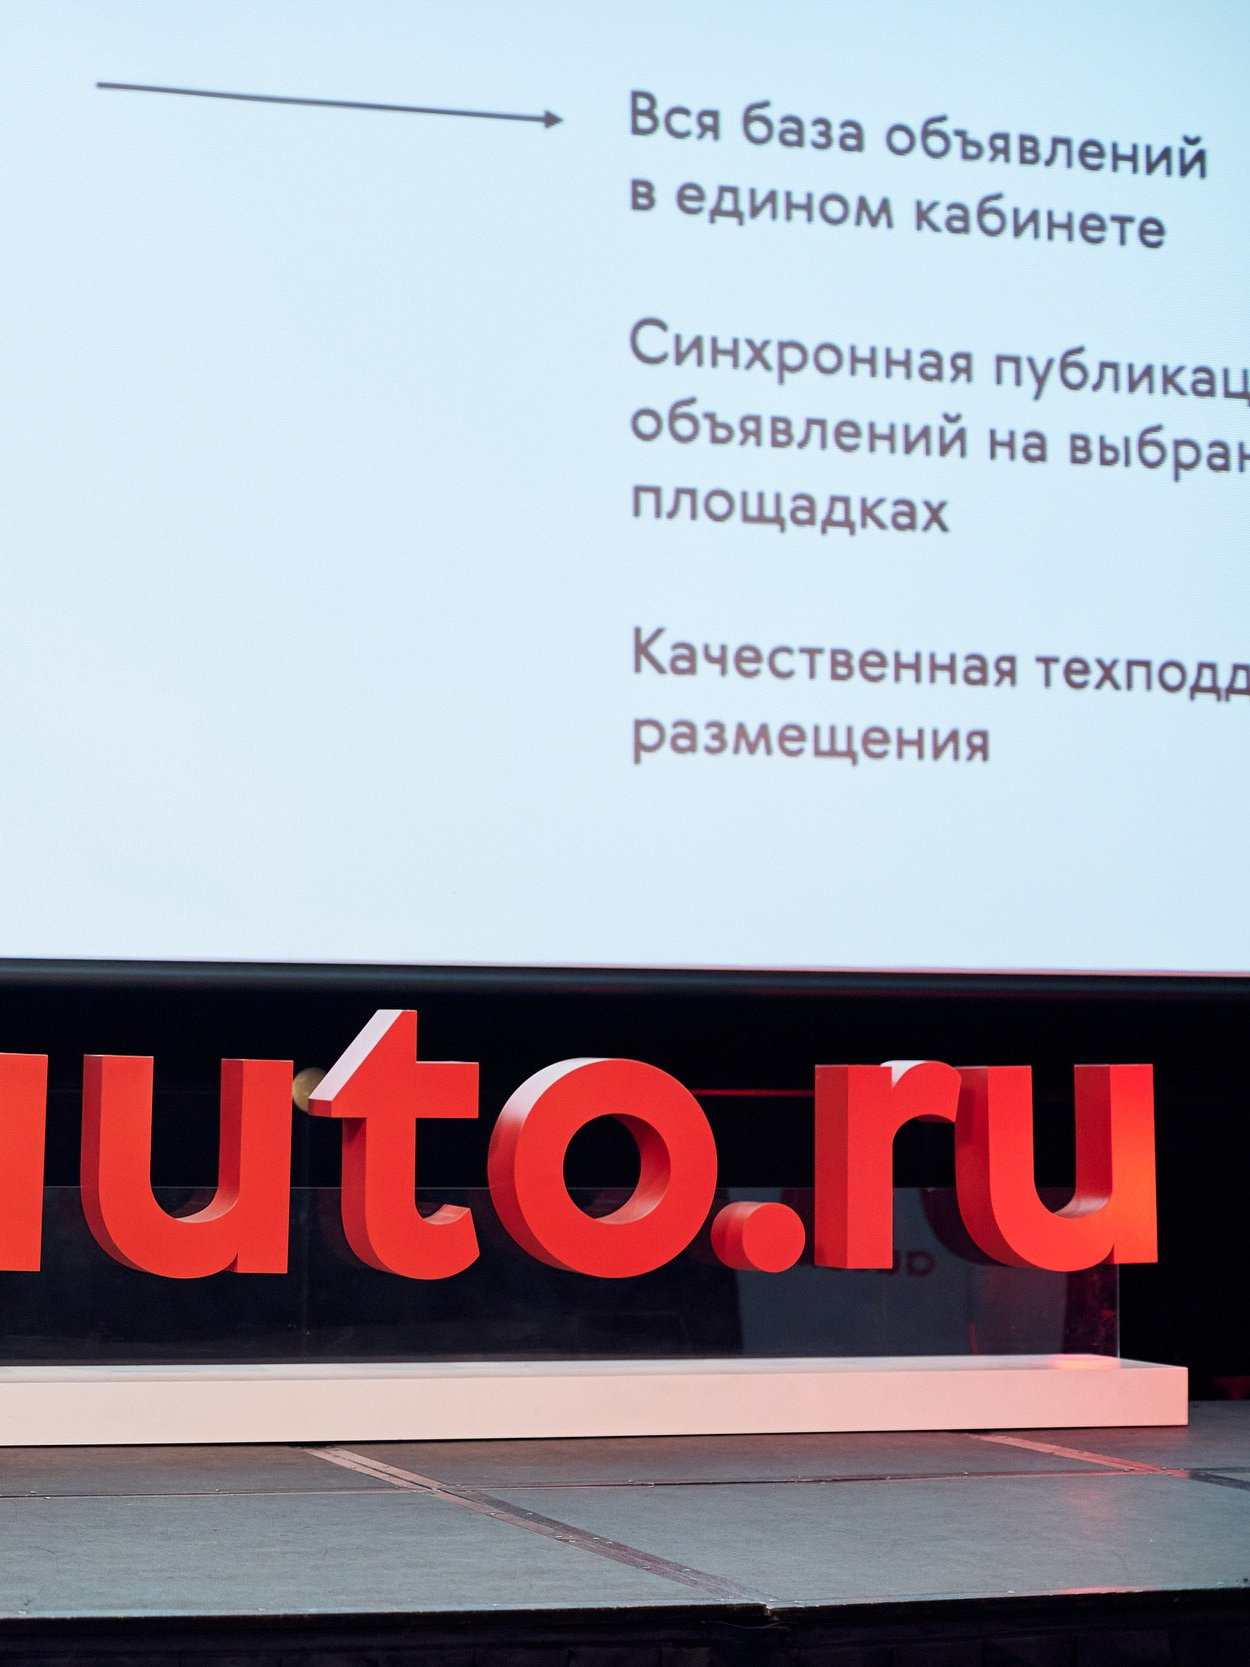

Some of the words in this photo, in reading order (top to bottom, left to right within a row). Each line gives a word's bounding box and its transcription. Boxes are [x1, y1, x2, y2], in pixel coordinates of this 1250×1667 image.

[630, 89, 721, 141] Вся
[742, 99, 865, 153] база
[886, 114, 1207, 180] объявлений
[631, 178, 657, 211] в
[676, 181, 894, 229] едином
[915, 192, 1167, 249] кабинете
[629, 316, 974, 386] Синхронная
[995, 345, 1250, 407] публикац
[631, 396, 968, 459] объявлений
[989, 428, 1048, 464] на
[633, 484, 950, 536] площадках
[634, 626, 1018, 688] Качественная
[1035, 656, 1250, 703] техподд
[633, 718, 990, 767] размещения
